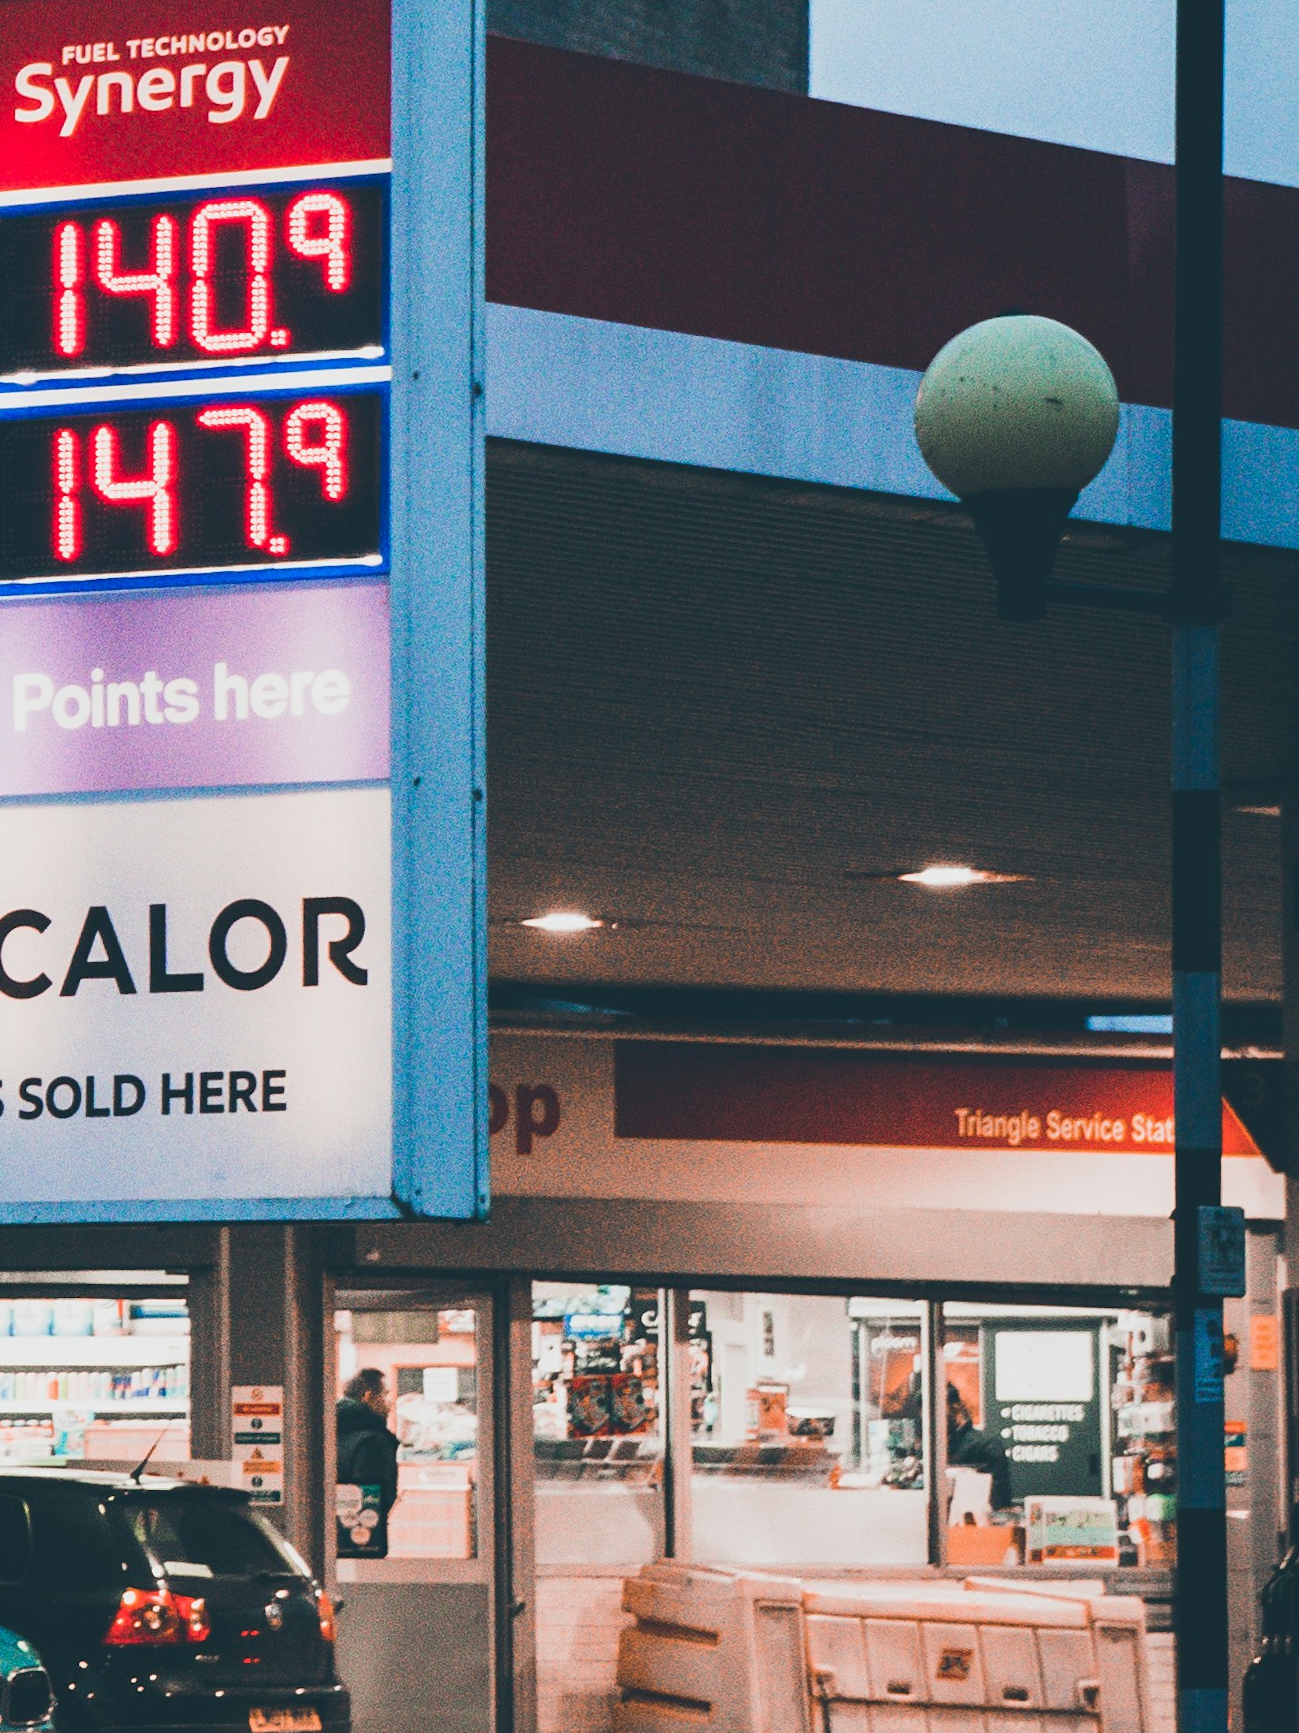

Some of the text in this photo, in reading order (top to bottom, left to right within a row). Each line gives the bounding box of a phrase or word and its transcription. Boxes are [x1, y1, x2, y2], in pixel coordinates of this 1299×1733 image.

[61, 25, 290, 66] FUEL TECHNOLOGY
[14, 56, 290, 137] Synergy
[12, 662, 352, 732] Points here
[18, 1074, 146, 1119] SOLD
[160, 1069, 287, 1115] HERE
[954, 1107, 1041, 1146] Triangle
[1046, 1109, 1125, 1143] Service
